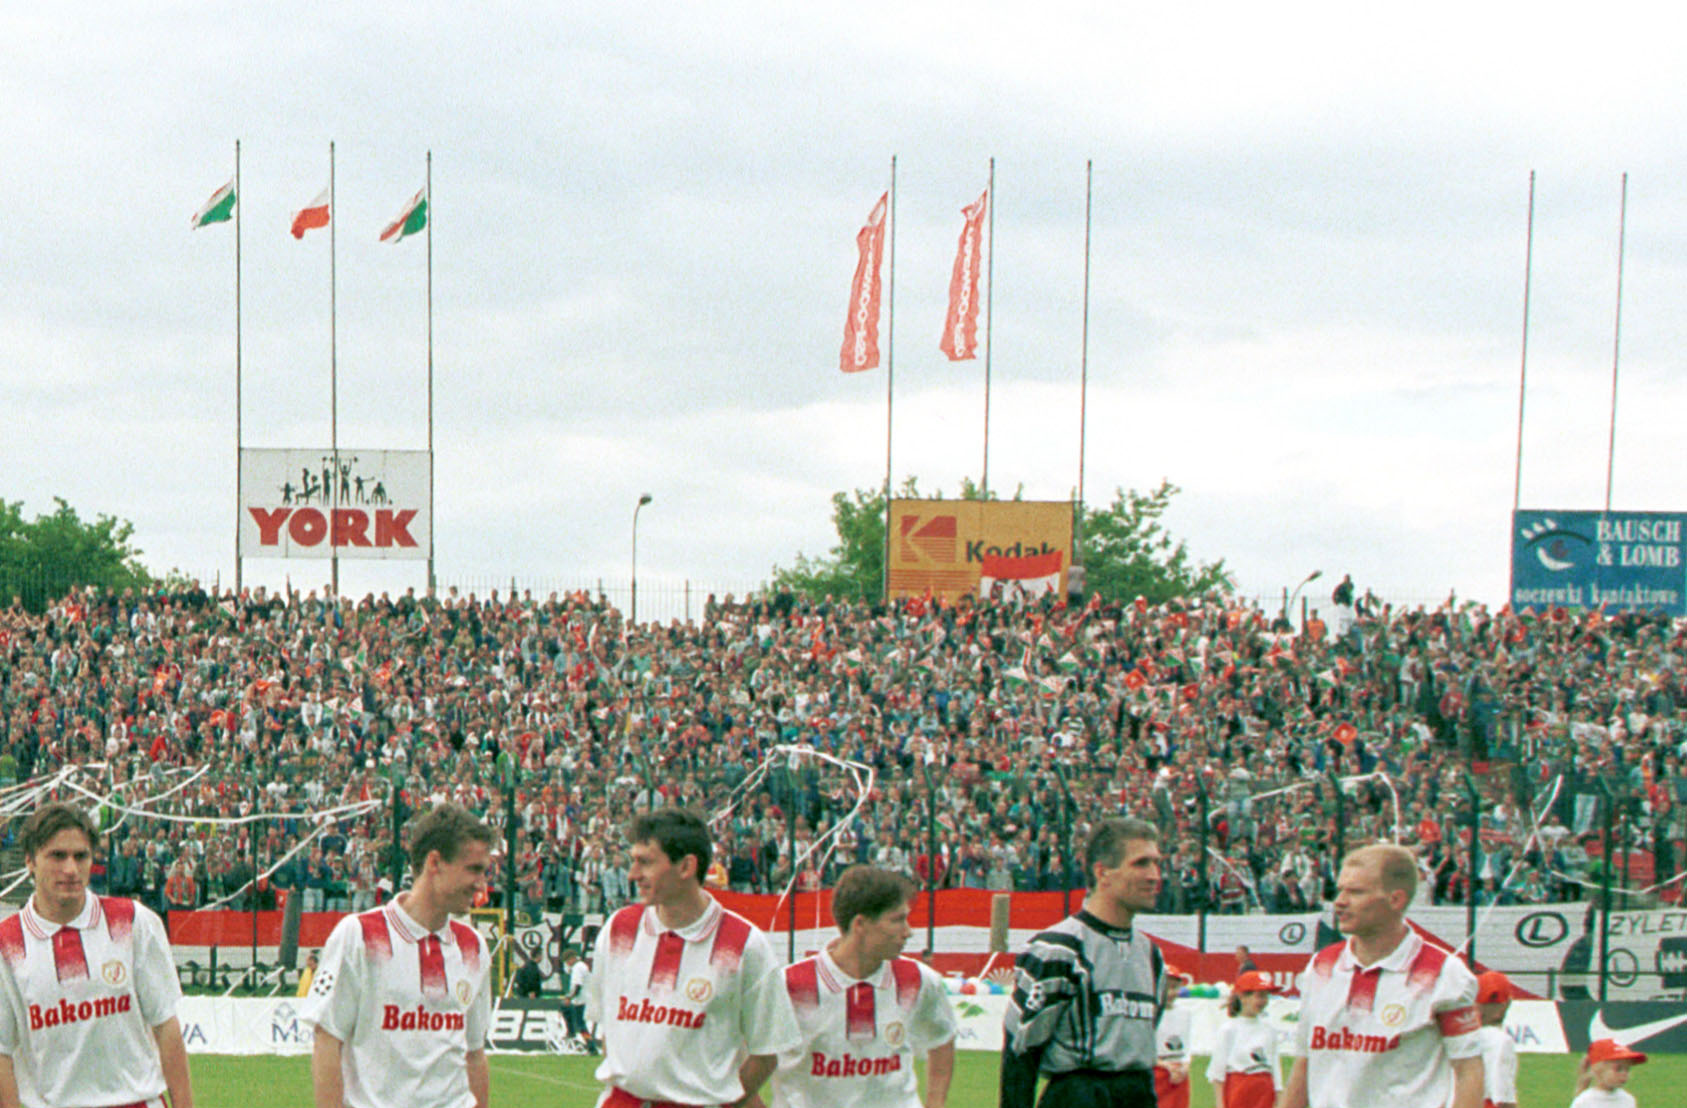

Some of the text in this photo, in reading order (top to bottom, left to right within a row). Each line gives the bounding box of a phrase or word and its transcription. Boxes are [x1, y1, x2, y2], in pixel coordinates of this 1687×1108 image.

[248, 507, 419, 547] YORK
[1596, 520, 1681, 542] BAUSCH
[1596, 543, 1680, 567] & LOMB
[28, 994, 131, 1031] Bakoma
[381, 1003, 465, 1032] Bakom
[810, 1051, 901, 1078] Bakoma
